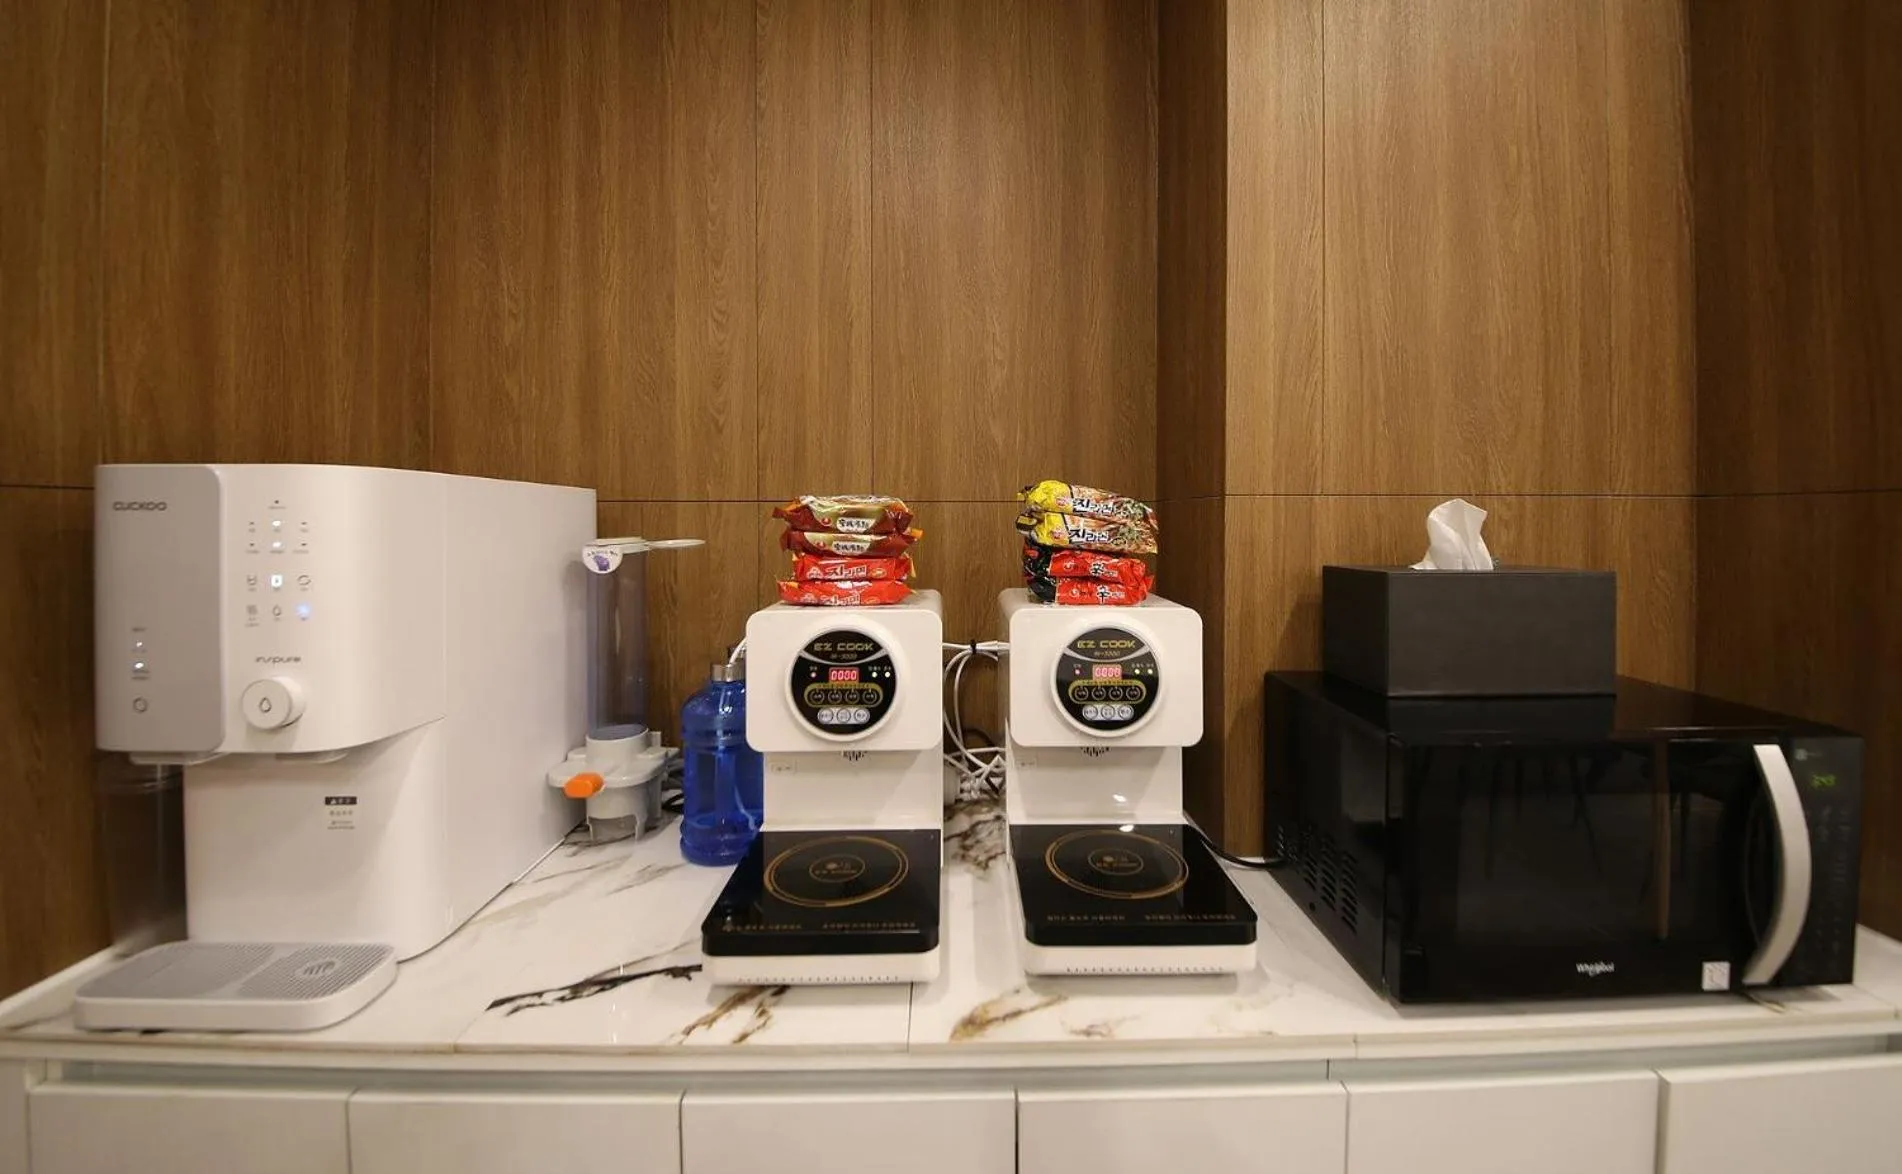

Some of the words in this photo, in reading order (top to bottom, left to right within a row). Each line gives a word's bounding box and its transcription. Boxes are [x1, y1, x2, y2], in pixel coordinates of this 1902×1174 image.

[113, 501, 167, 511] CUCKOO
[814, 642, 832, 651] EZ
[837, 642, 873, 651] COOK
[1077, 640, 1096, 648] EZ
[1100, 640, 1135, 648] COOK
[831, 670, 857, 680] 0000
[1094, 667, 1120, 677] 0000
